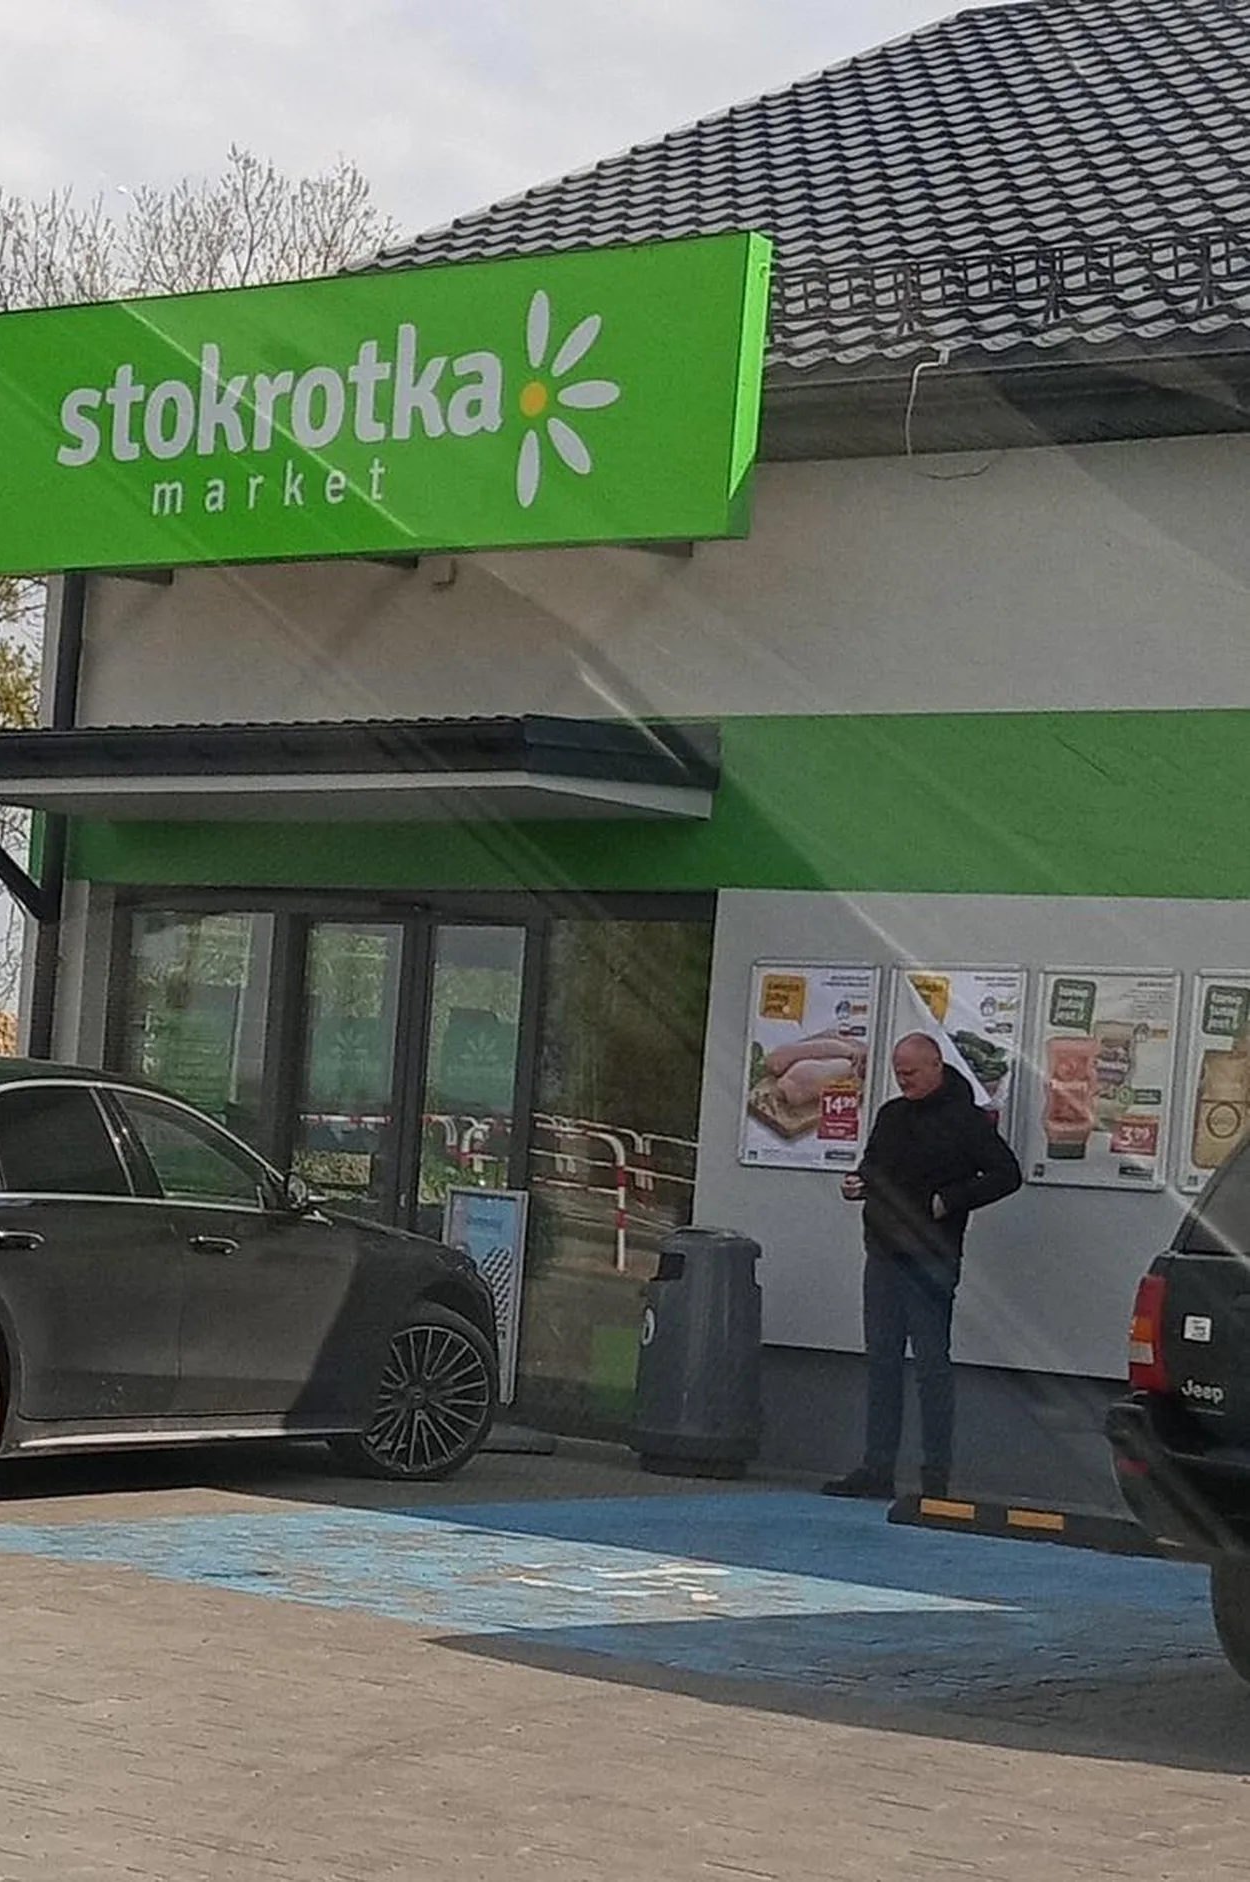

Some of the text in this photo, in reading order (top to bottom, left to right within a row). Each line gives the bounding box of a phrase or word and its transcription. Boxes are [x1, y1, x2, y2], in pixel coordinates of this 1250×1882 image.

[56, 323, 503, 467] stokrotka
[152, 457, 386, 516] market
[1181, 1379, 1224, 1405] Jeep
